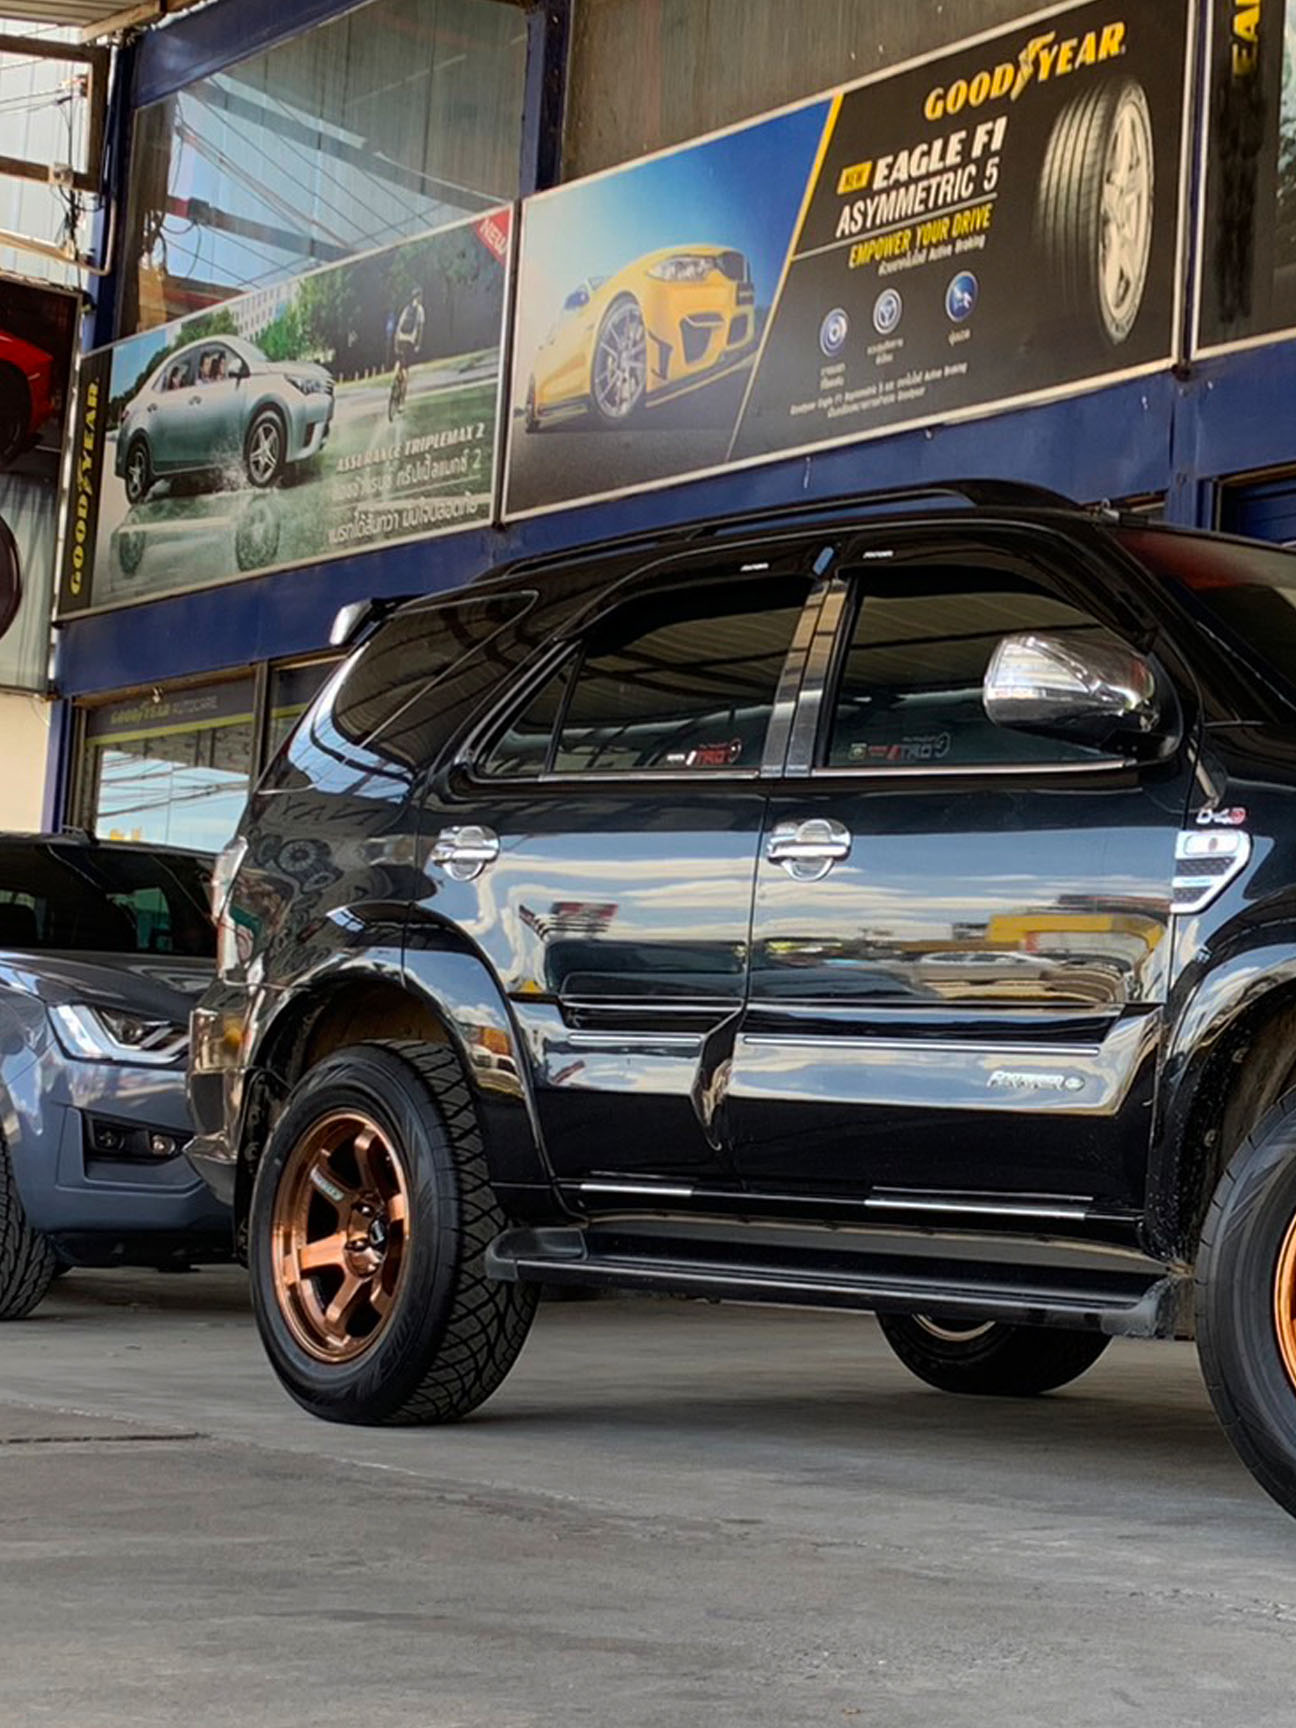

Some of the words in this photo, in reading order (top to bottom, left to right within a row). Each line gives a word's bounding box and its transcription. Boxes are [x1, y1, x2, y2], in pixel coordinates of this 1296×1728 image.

[924, 22, 1125, 121] GOODYEAR
[1233, 0, 1260, 74] EA
[873, 130, 966, 191] EAGLE
[836, 163, 976, 238] ASYMMETRIC
[983, 156, 999, 192] 5
[849, 227, 911, 269] EMPOWER
[915, 217, 949, 248] YOUR
[951, 202, 993, 235] DRIVE
[405, 426, 473, 455] TRIPLEMAX
[475, 422, 484, 438] 2
[472, 449, 482, 469] 2
[70, 380, 100, 595] GOODYEAR
